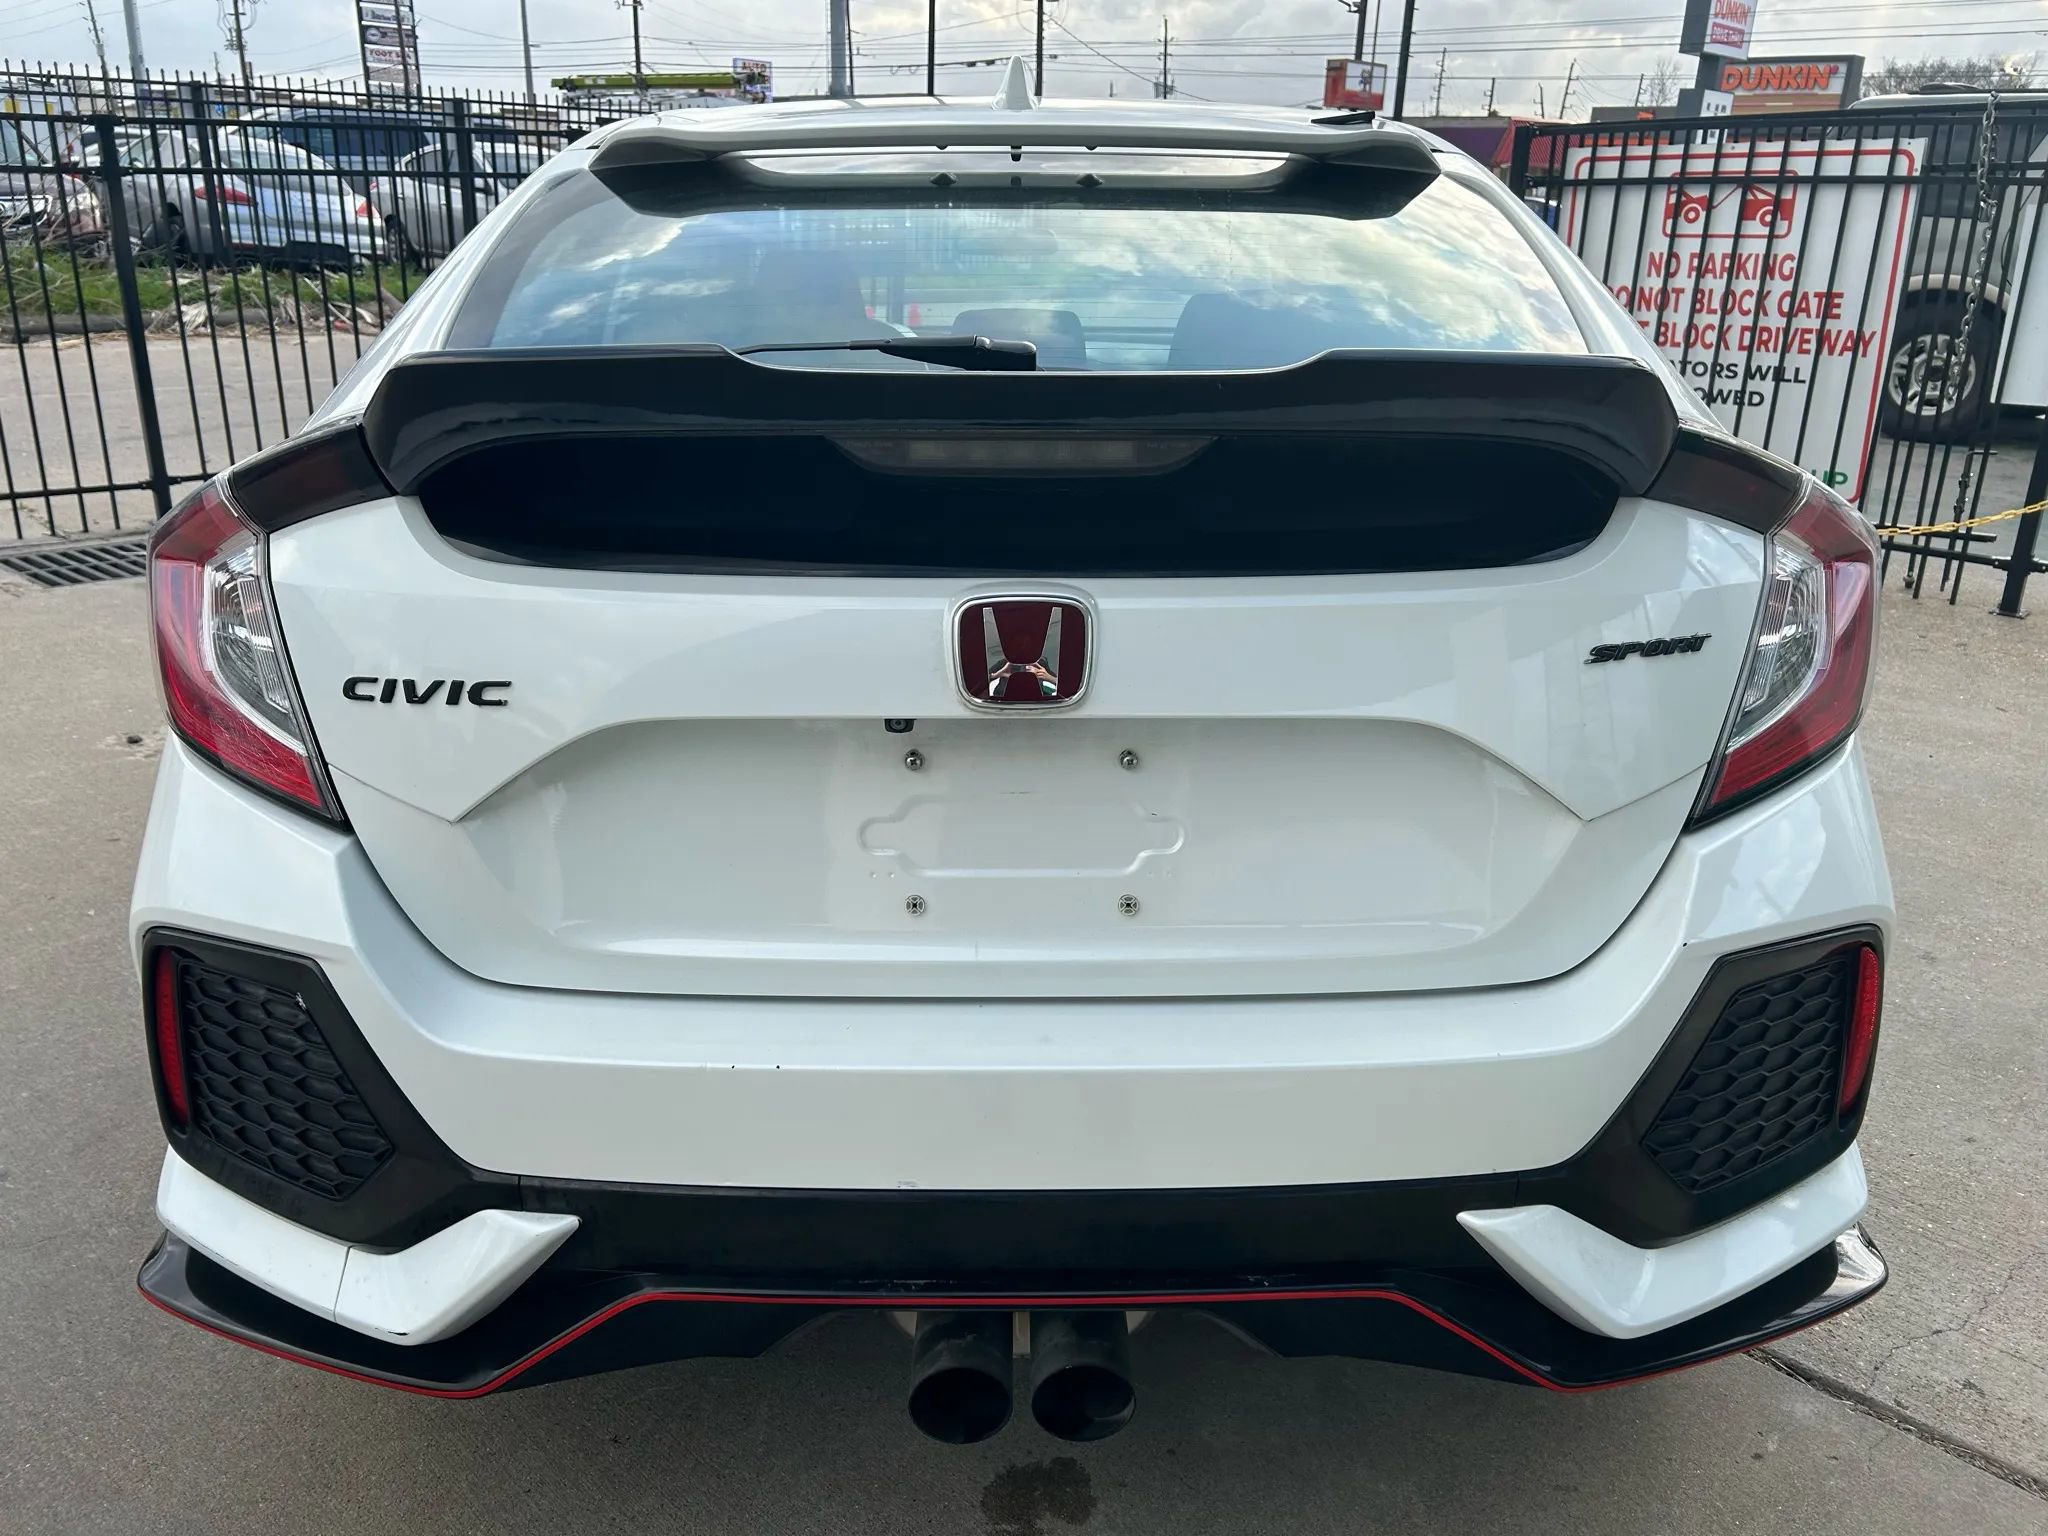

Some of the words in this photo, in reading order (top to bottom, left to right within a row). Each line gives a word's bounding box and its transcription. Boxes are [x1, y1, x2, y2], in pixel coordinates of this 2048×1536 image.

[1647, 252, 1681, 279] NO
[1687, 252, 1797, 281] PARKING
[1637, 286, 1685, 314] NOT
[1693, 288, 1772, 316] BLOCK
[1657, 321, 1732, 351] BLOCK
[1738, 325, 1877, 358] DRIVEWAY
[1748, 363, 1806, 384] WILL
[1583, 633, 1712, 664] SPORT
[343, 676, 512, 706] CIVIC
